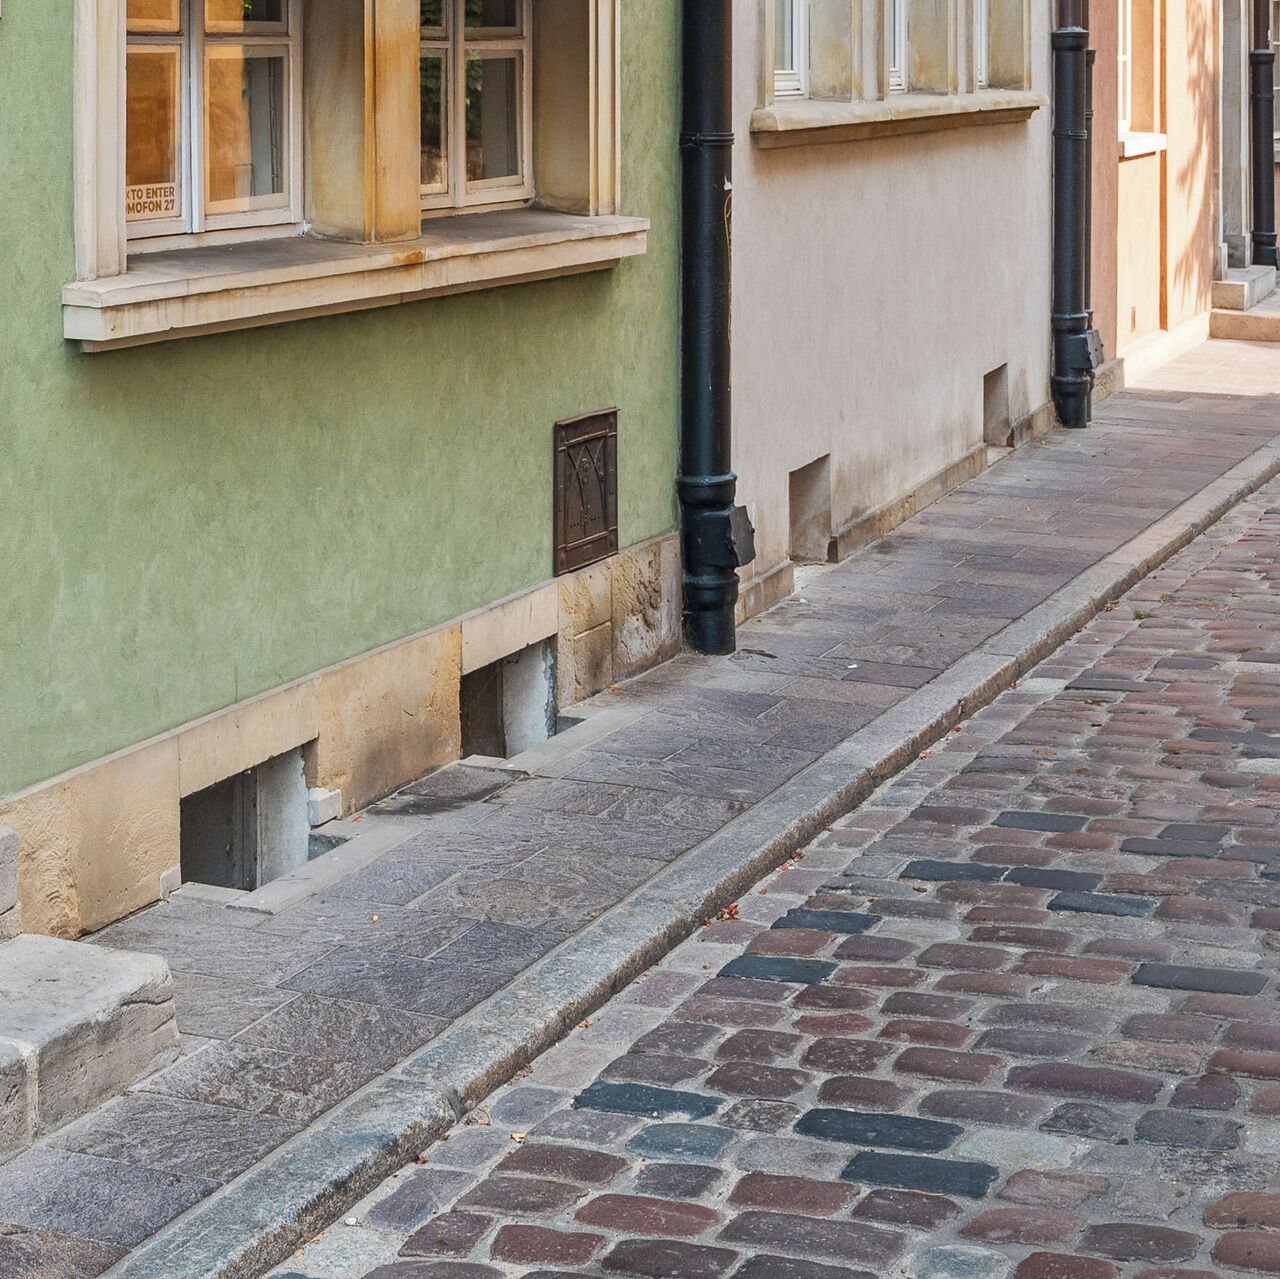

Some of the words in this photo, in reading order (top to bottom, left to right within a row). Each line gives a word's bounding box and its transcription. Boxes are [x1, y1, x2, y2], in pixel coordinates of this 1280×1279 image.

[131, 189, 144, 200] TO
[146, 186, 175, 199] ENTER
[164, 199, 175, 210] 27
